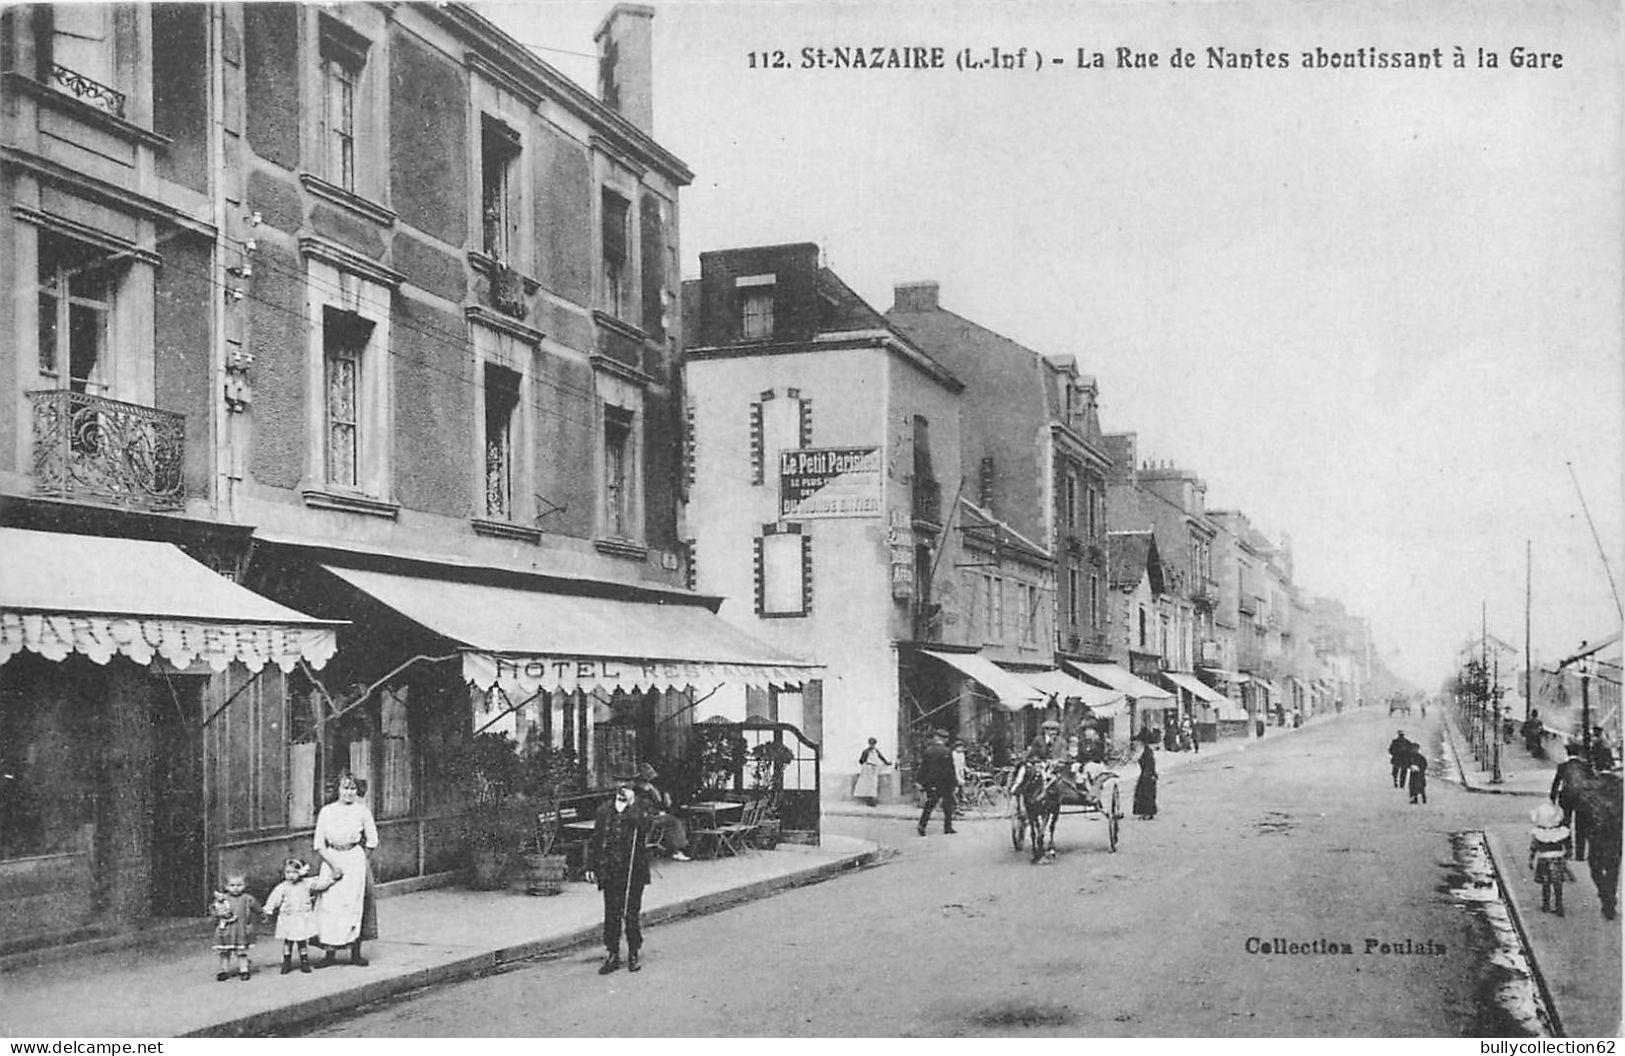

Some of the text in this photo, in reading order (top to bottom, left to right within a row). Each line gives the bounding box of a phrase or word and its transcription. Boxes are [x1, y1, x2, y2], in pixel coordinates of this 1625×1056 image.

[782, 453, 797, 475] Le
[799, 452, 827, 474] Petit
[783, 500, 799, 513] DU
